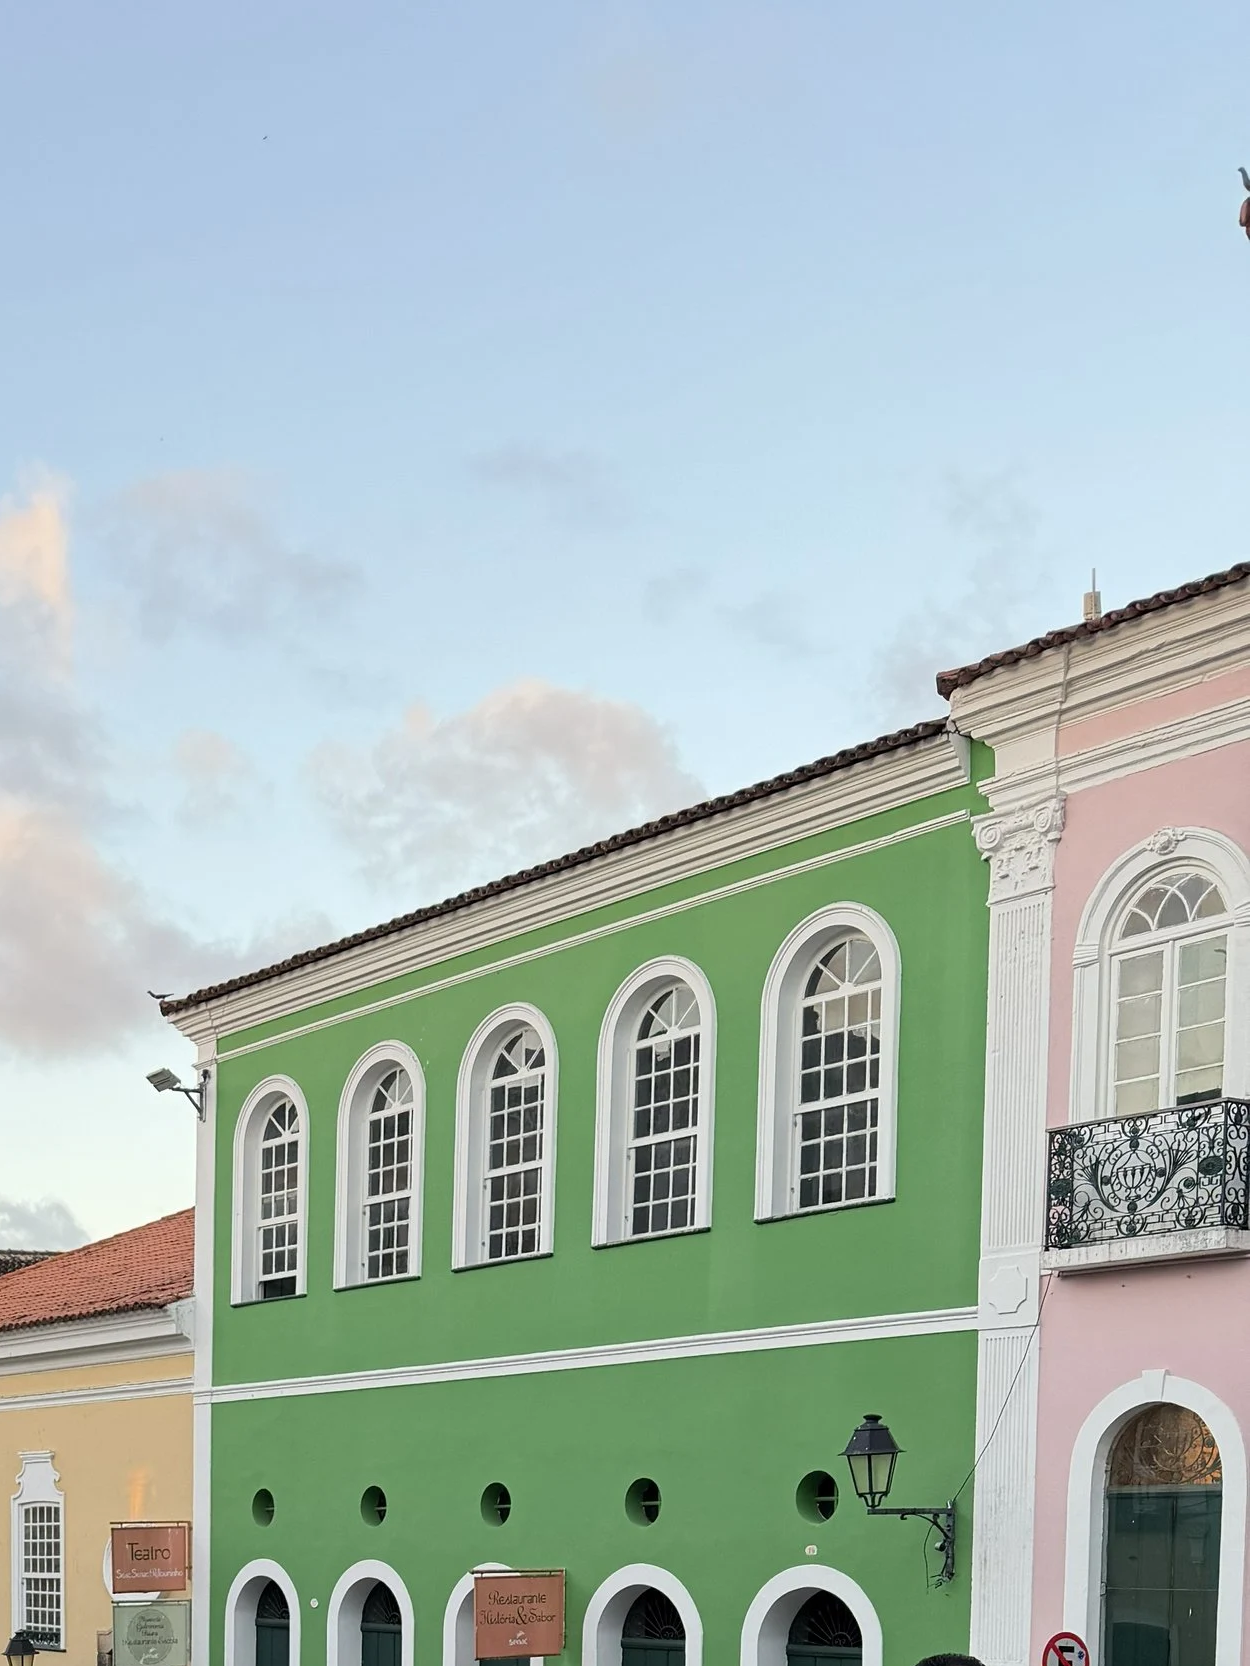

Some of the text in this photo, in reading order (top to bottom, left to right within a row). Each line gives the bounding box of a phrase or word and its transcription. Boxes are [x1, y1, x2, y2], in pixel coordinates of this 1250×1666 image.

[127, 1542, 171, 1561] Teatro
[488, 1590, 547, 1605] Restaurante
[479, 1609, 516, 1625] História
[528, 1607, 556, 1623] Sabor
